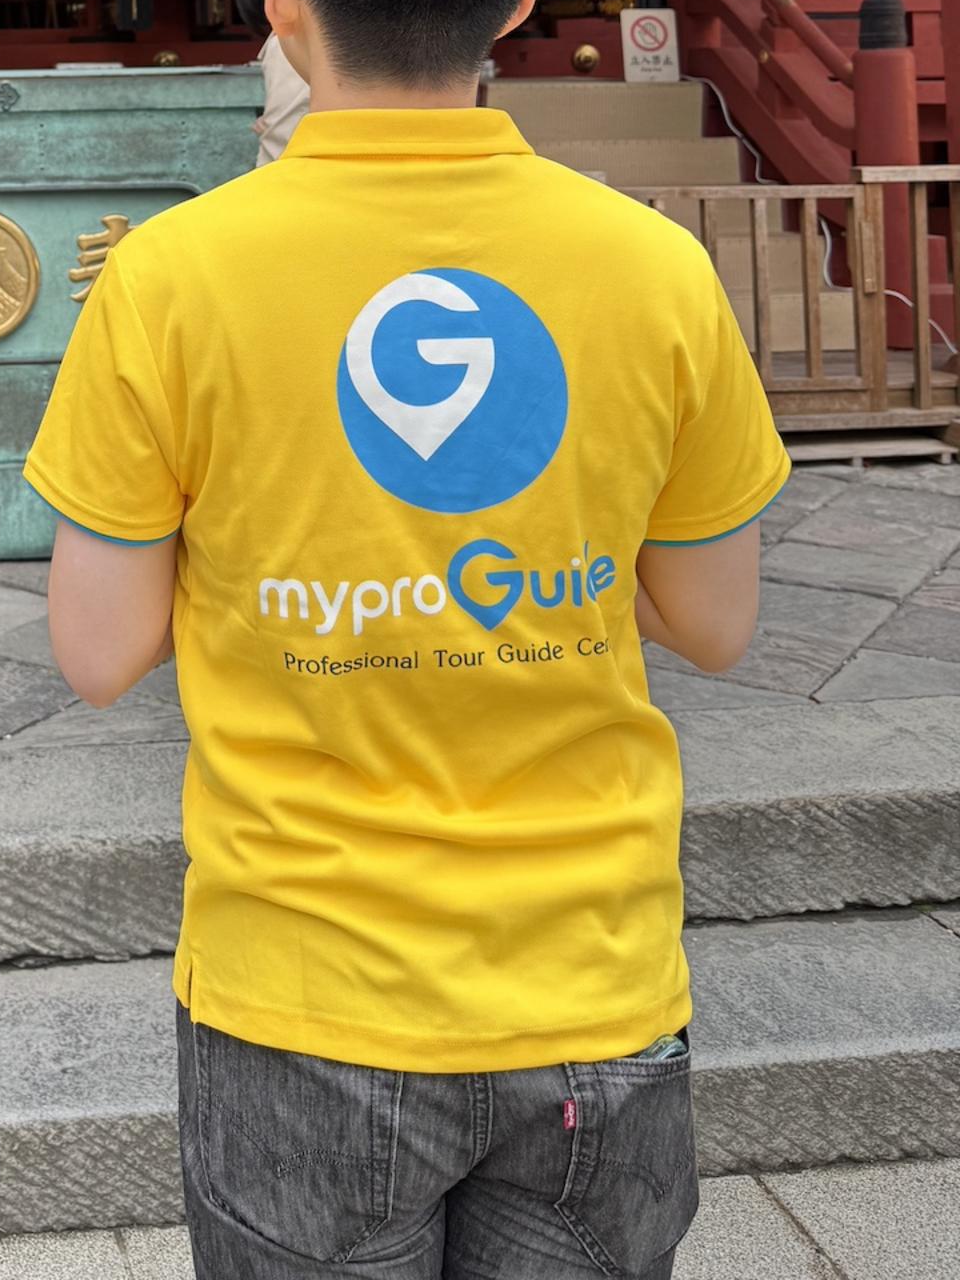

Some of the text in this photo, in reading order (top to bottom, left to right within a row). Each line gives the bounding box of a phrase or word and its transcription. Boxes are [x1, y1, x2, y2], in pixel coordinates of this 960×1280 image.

[284, 650, 420, 677] Professional
[434, 648, 486, 669] Tour
[497, 641, 565, 664] Guide
